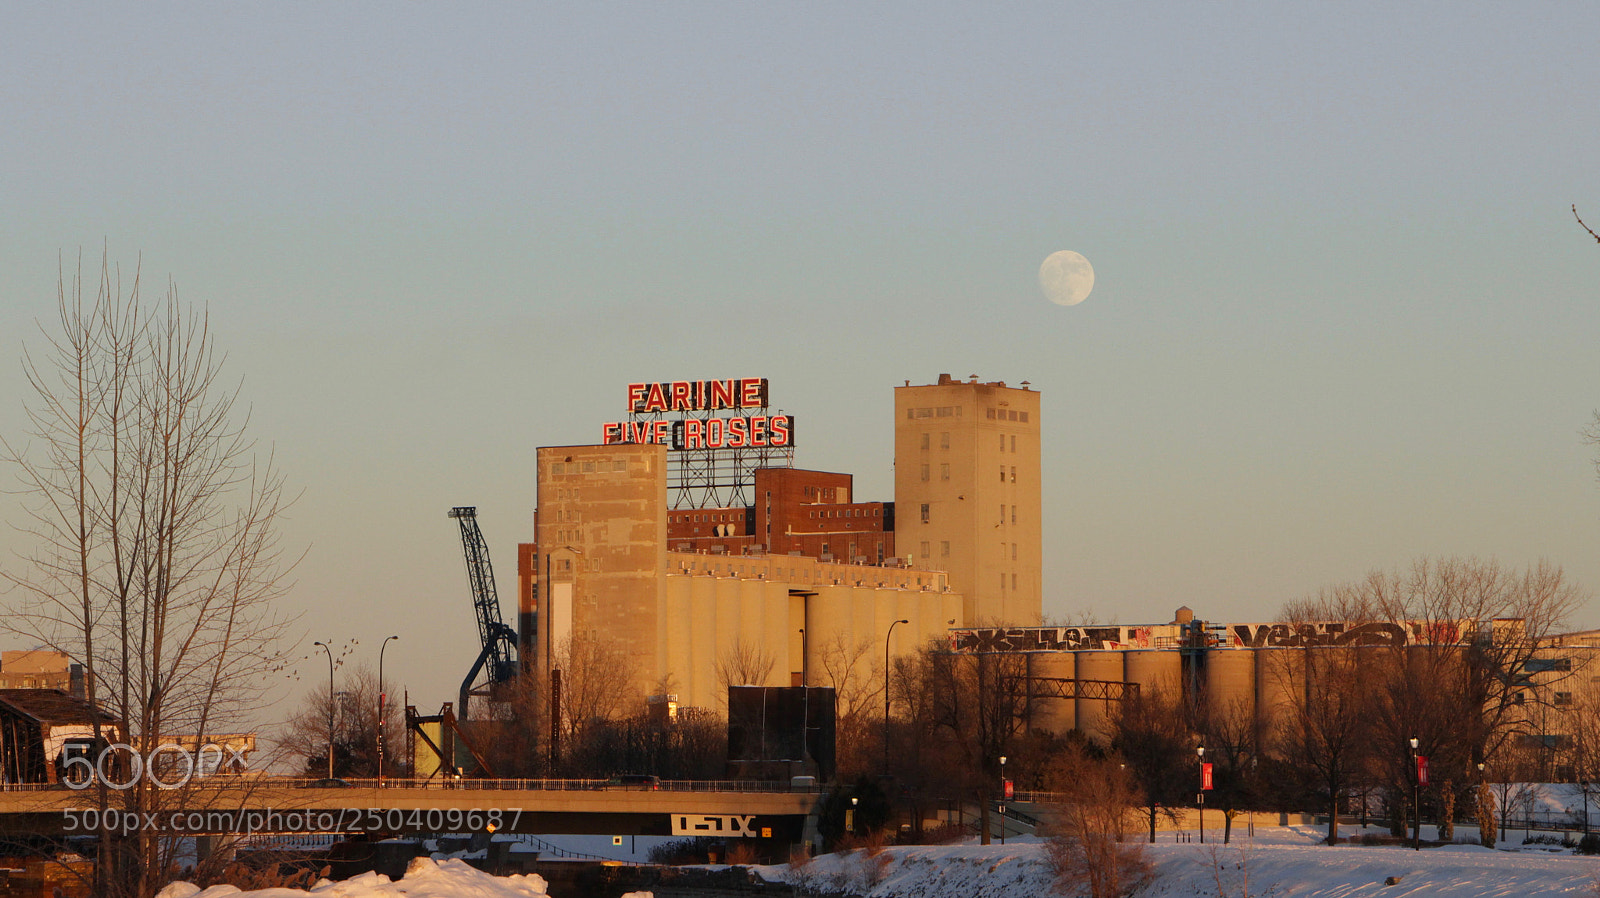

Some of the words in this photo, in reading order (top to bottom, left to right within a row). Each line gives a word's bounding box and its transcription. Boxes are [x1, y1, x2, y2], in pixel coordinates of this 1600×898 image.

[627, 377, 762, 412] FARINE
[603, 420, 668, 445] FIVE
[684, 415, 789, 449] ROSES
